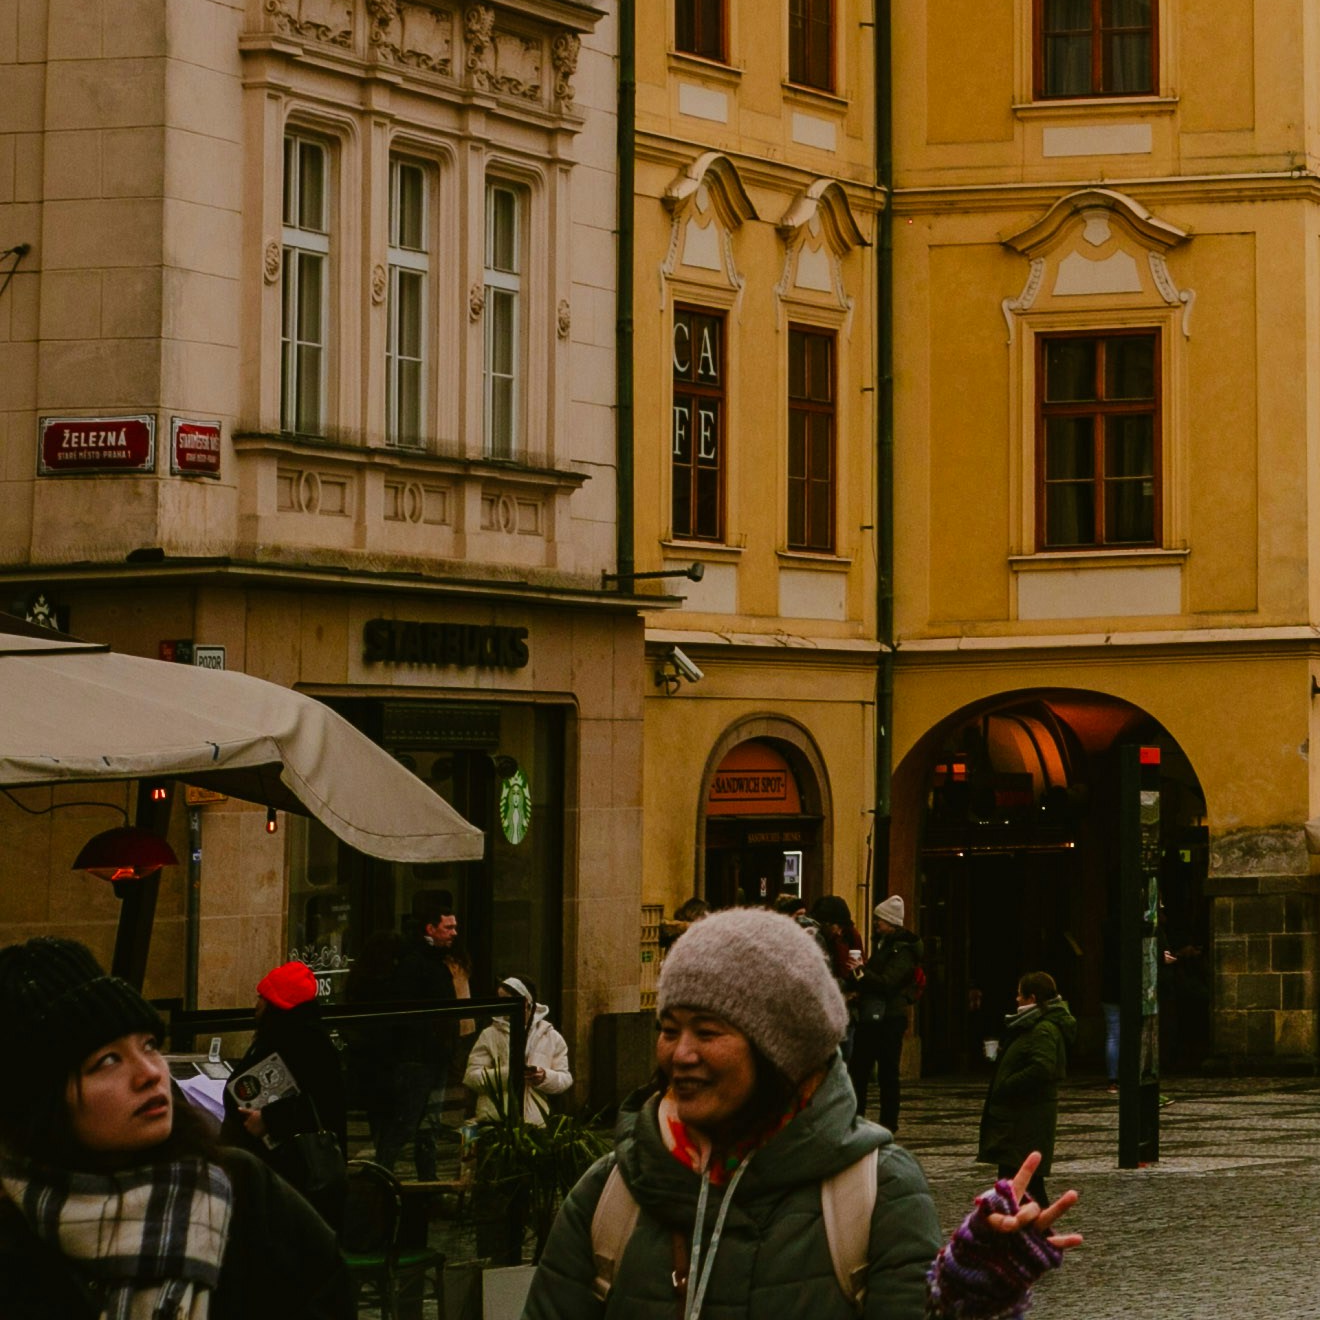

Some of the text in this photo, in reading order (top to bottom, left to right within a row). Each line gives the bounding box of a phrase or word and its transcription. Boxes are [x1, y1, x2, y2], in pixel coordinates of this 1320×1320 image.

[62, 428, 127, 448] ŽELEZNÁ
[364, 620, 529, 669] STARBUCKS
[199, 656, 222, 669] POZOR
[715, 776, 782, 794] SANDWICH SPOT
